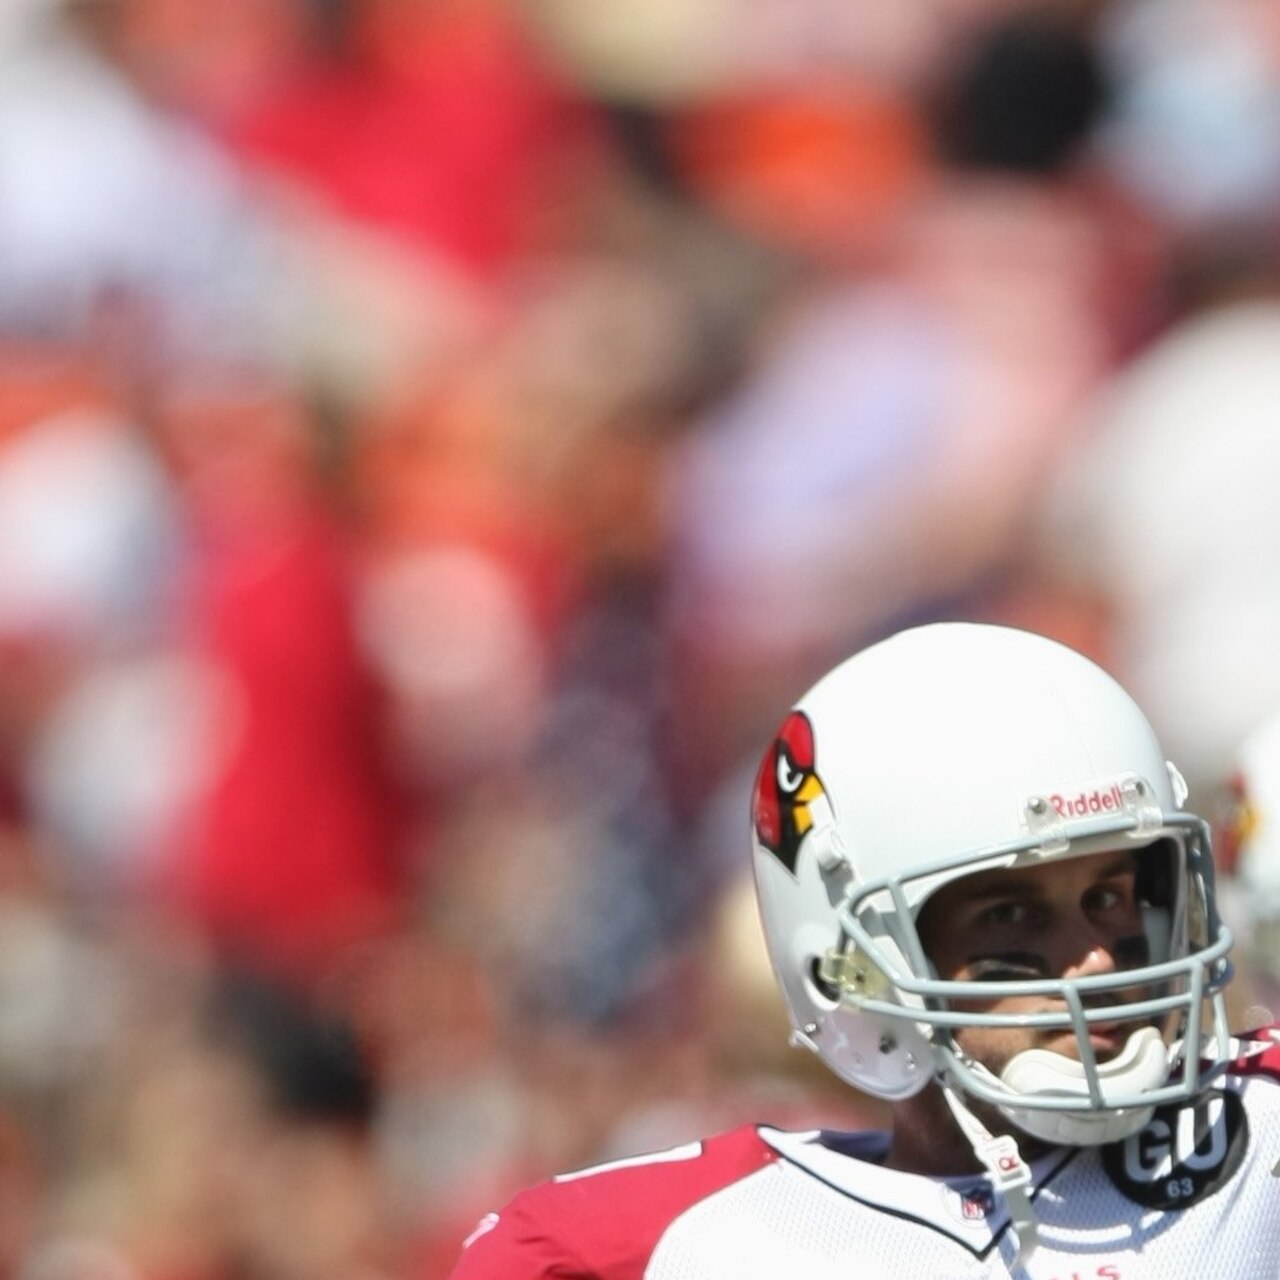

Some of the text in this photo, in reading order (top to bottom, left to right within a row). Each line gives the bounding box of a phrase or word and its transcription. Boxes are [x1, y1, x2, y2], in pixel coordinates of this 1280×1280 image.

[1049, 784, 1124, 818] Riddell
[1125, 1097, 1227, 1182] GU
[1166, 1177, 1194, 1198] 63
